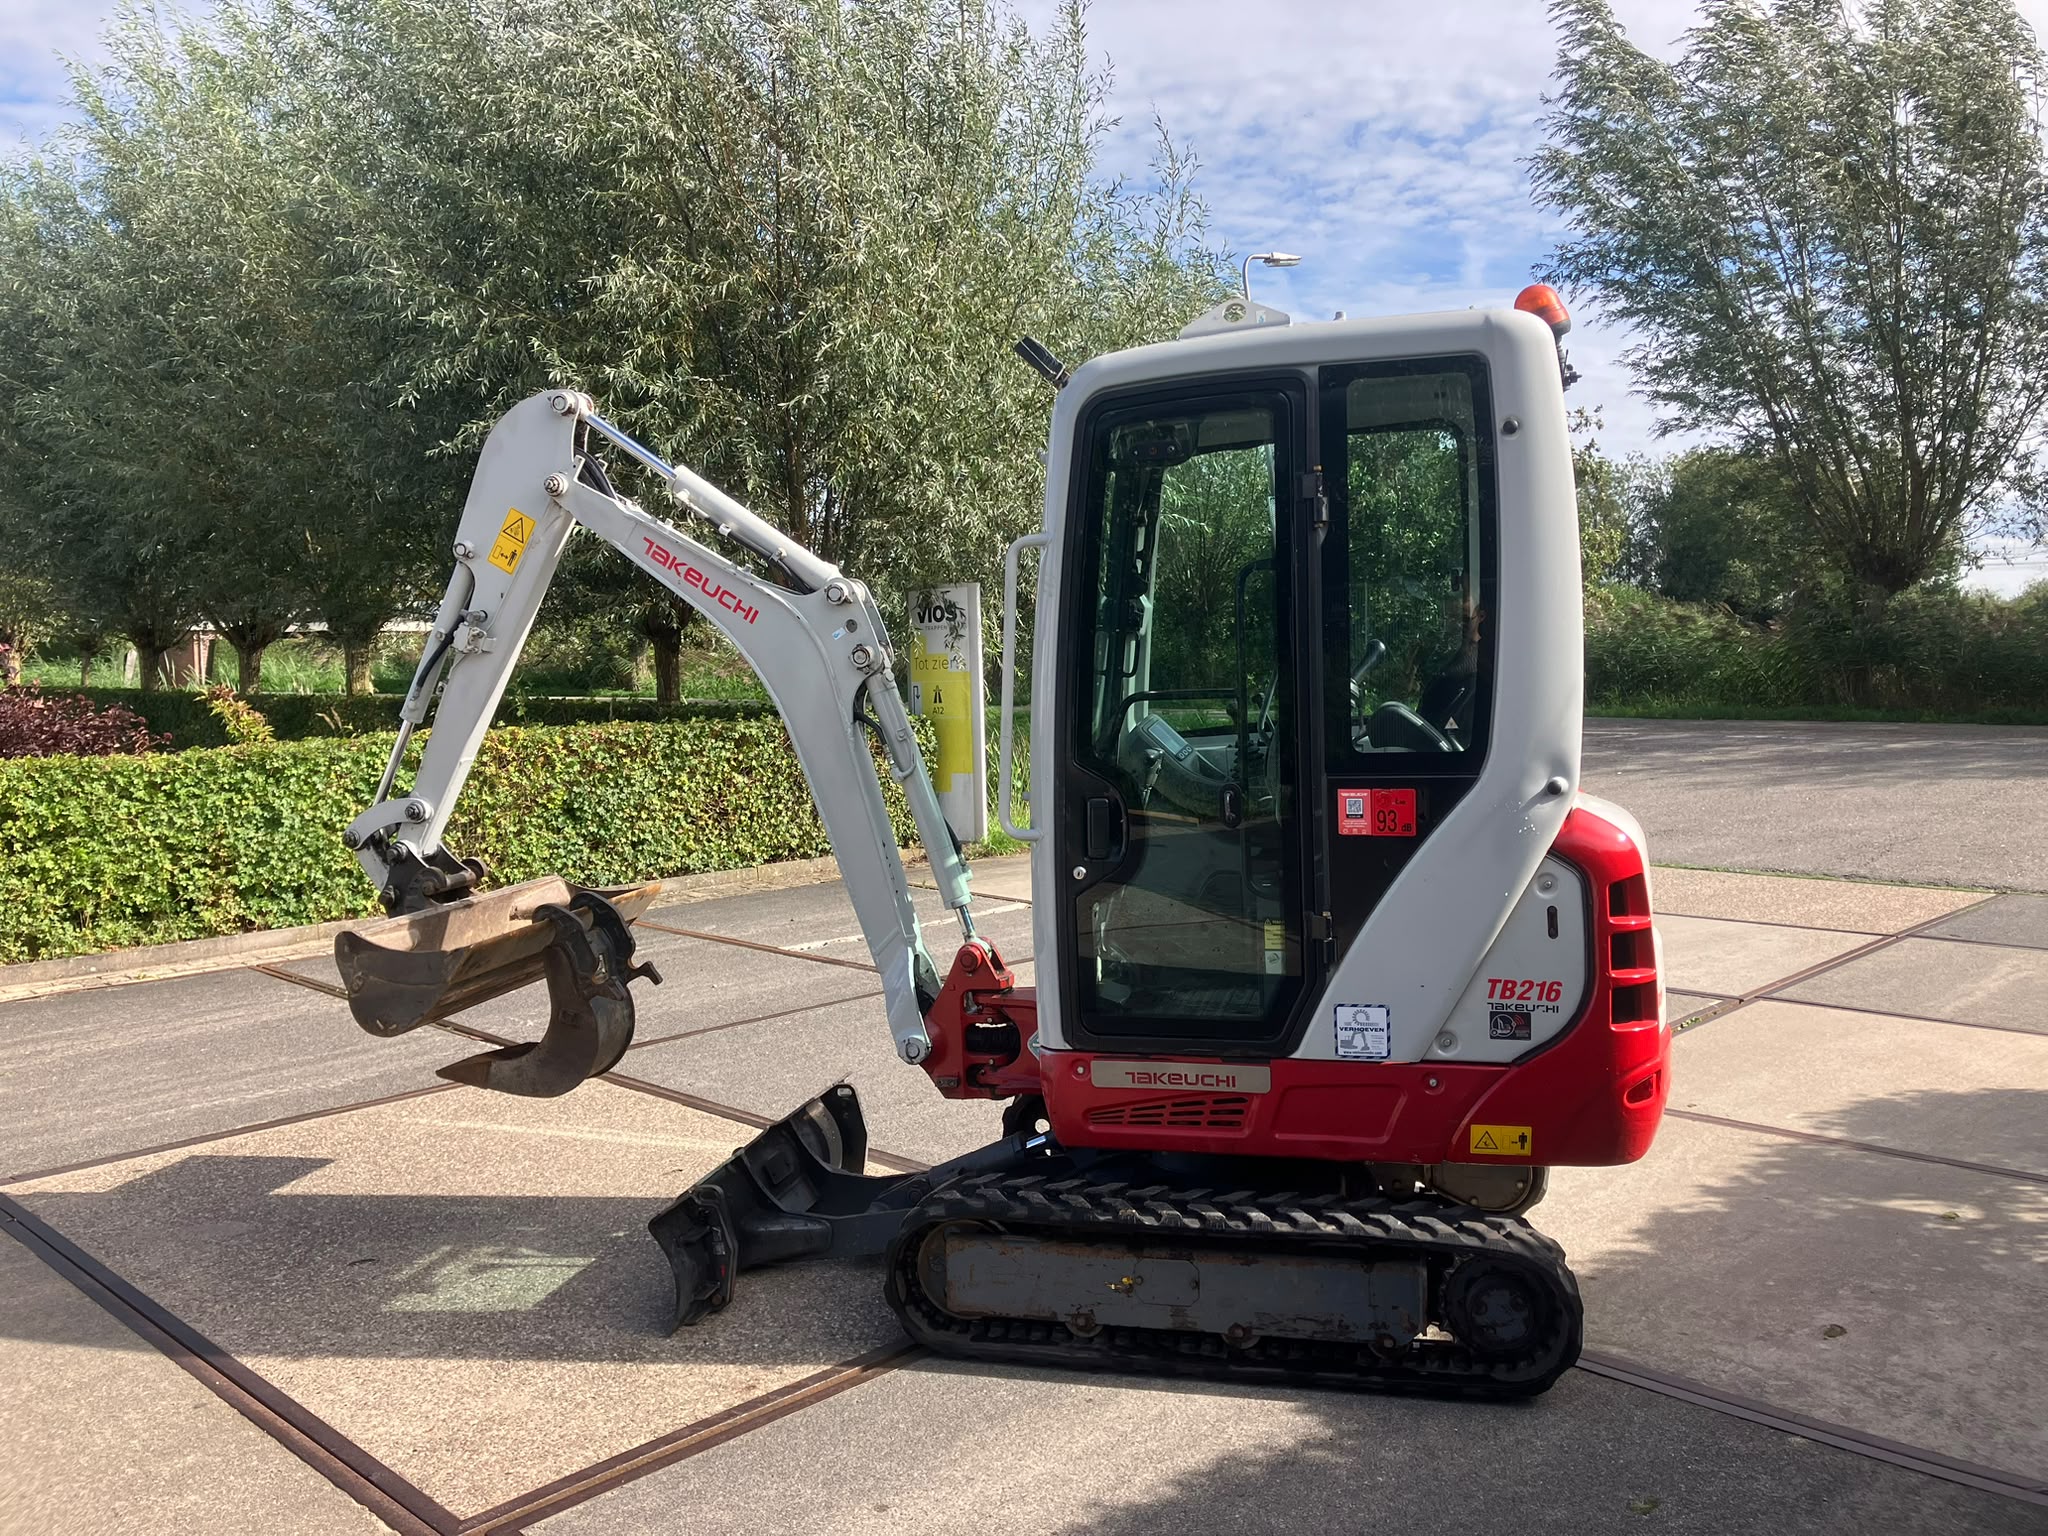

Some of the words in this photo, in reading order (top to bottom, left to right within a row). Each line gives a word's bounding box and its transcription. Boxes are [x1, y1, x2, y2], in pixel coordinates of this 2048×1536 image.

[643, 536, 759, 625] TAKEUCHI
[914, 657, 929, 670] Tot
[932, 706, 945, 715] A12
[1377, 810, 1398, 832] 93
[1402, 823, 1412, 832] dB
[1487, 978, 1563, 1002] TB216
[1125, 1071, 1237, 1088] TAKEUCHI
